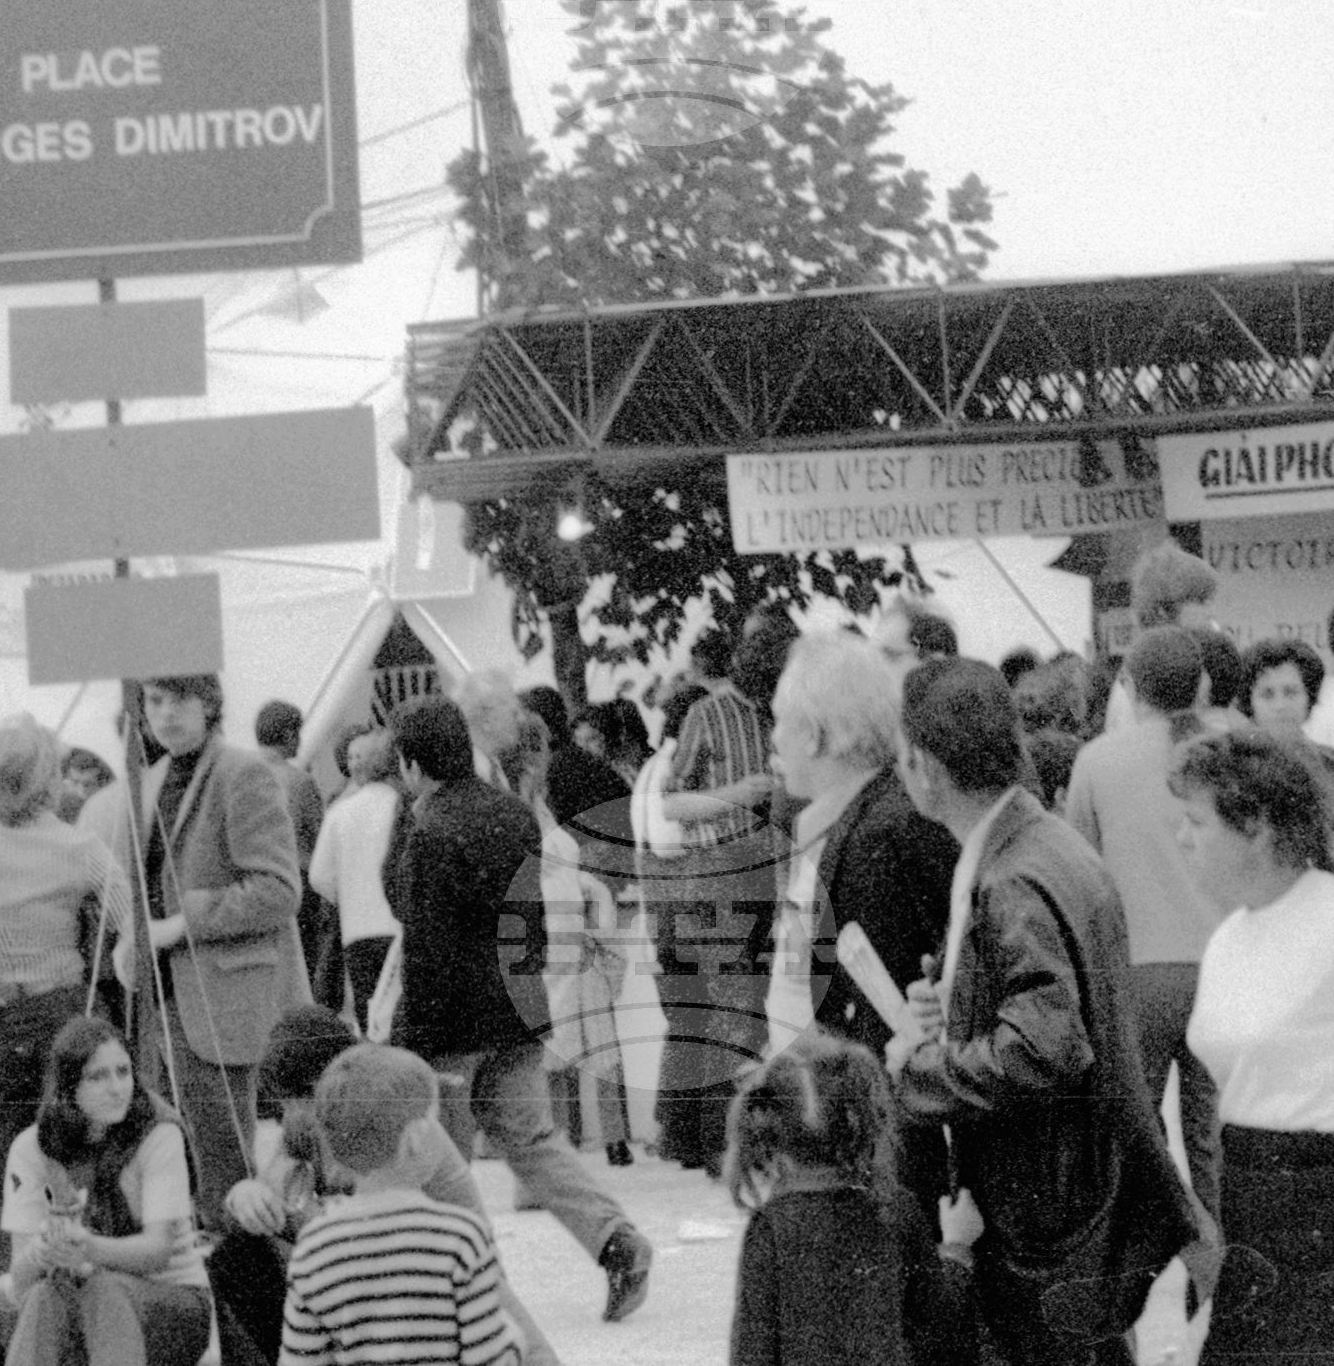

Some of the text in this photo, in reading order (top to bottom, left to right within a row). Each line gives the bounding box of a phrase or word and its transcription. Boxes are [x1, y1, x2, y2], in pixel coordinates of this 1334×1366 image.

[20, 45, 162, 94] PLACE
[115, 104, 324, 157] DIMITROV
[835, 454, 912, 492] N'EST
[930, 453, 986, 489] PLUS
[748, 501, 958, 546] L'INDEPENDANCE
[976, 498, 1003, 534] ET
[1021, 493, 1049, 531] LA
